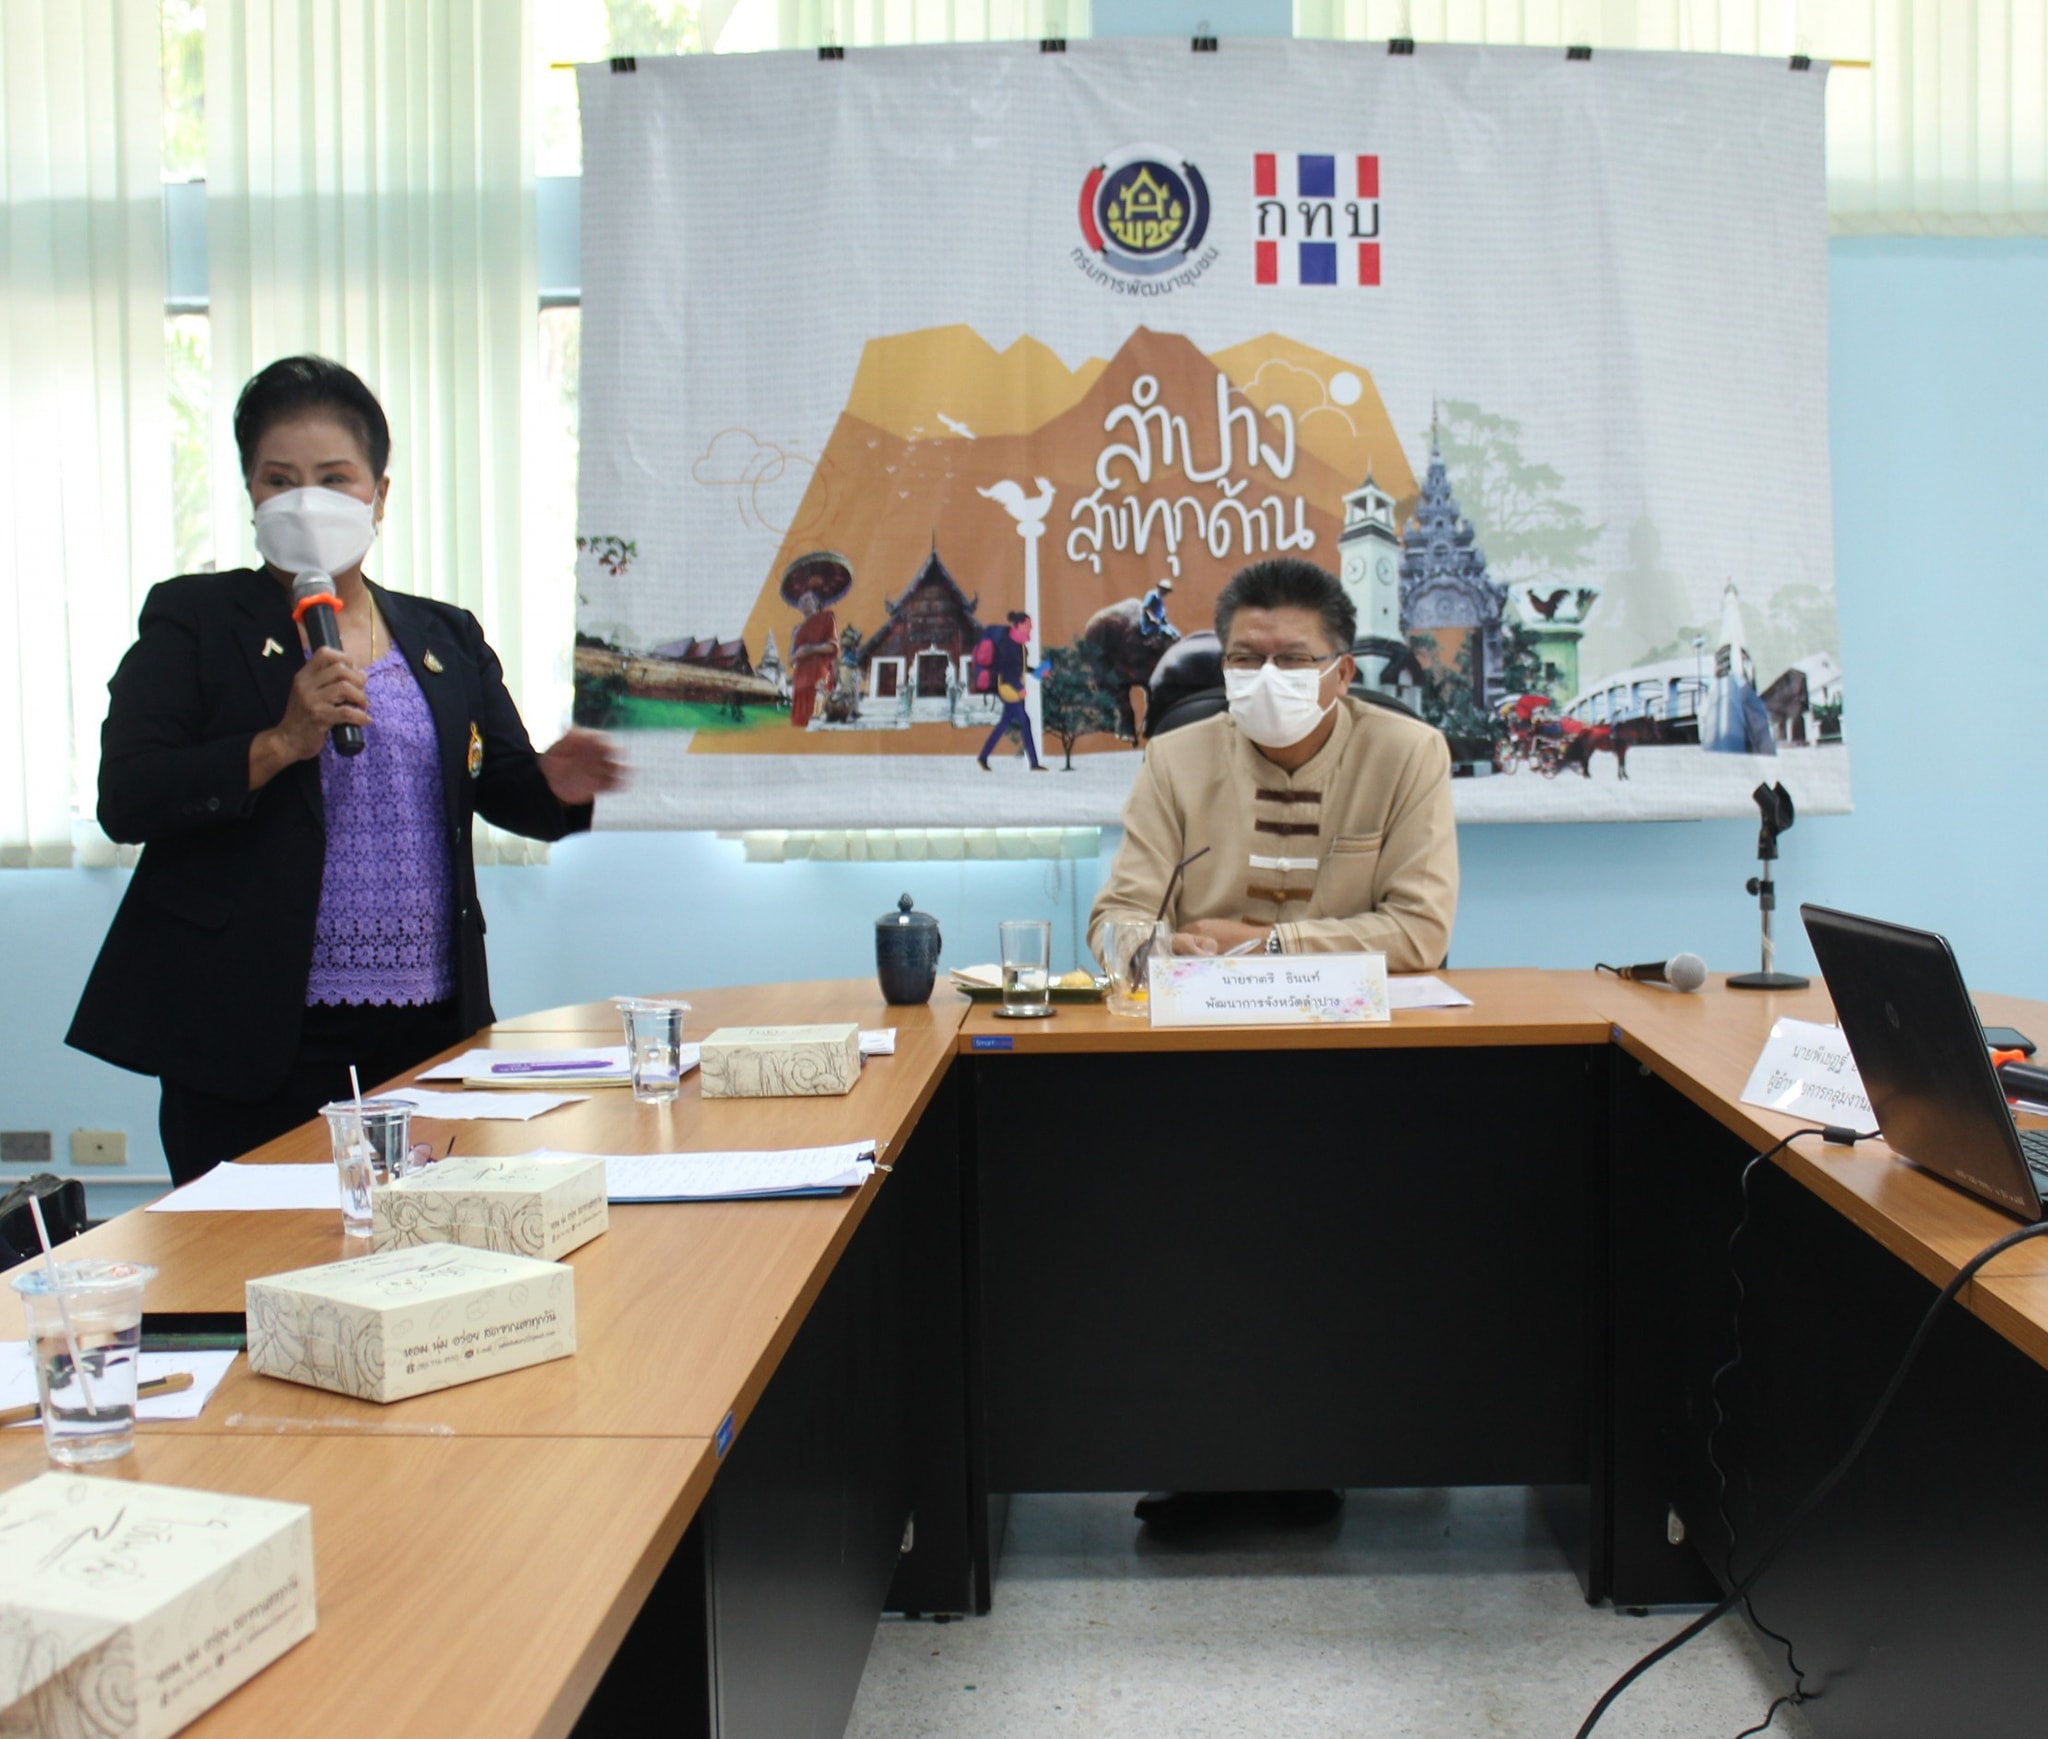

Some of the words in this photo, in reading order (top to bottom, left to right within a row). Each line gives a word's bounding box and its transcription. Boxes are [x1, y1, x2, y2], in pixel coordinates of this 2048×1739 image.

[1255, 200, 1380, 238] กทบ
[1070, 246, 1220, 297] กรมการพัฒนาชุมชน
[1096, 372, 1295, 490] ลำปาง
[1066, 477, 1316, 577] สุขทุกด้าน
